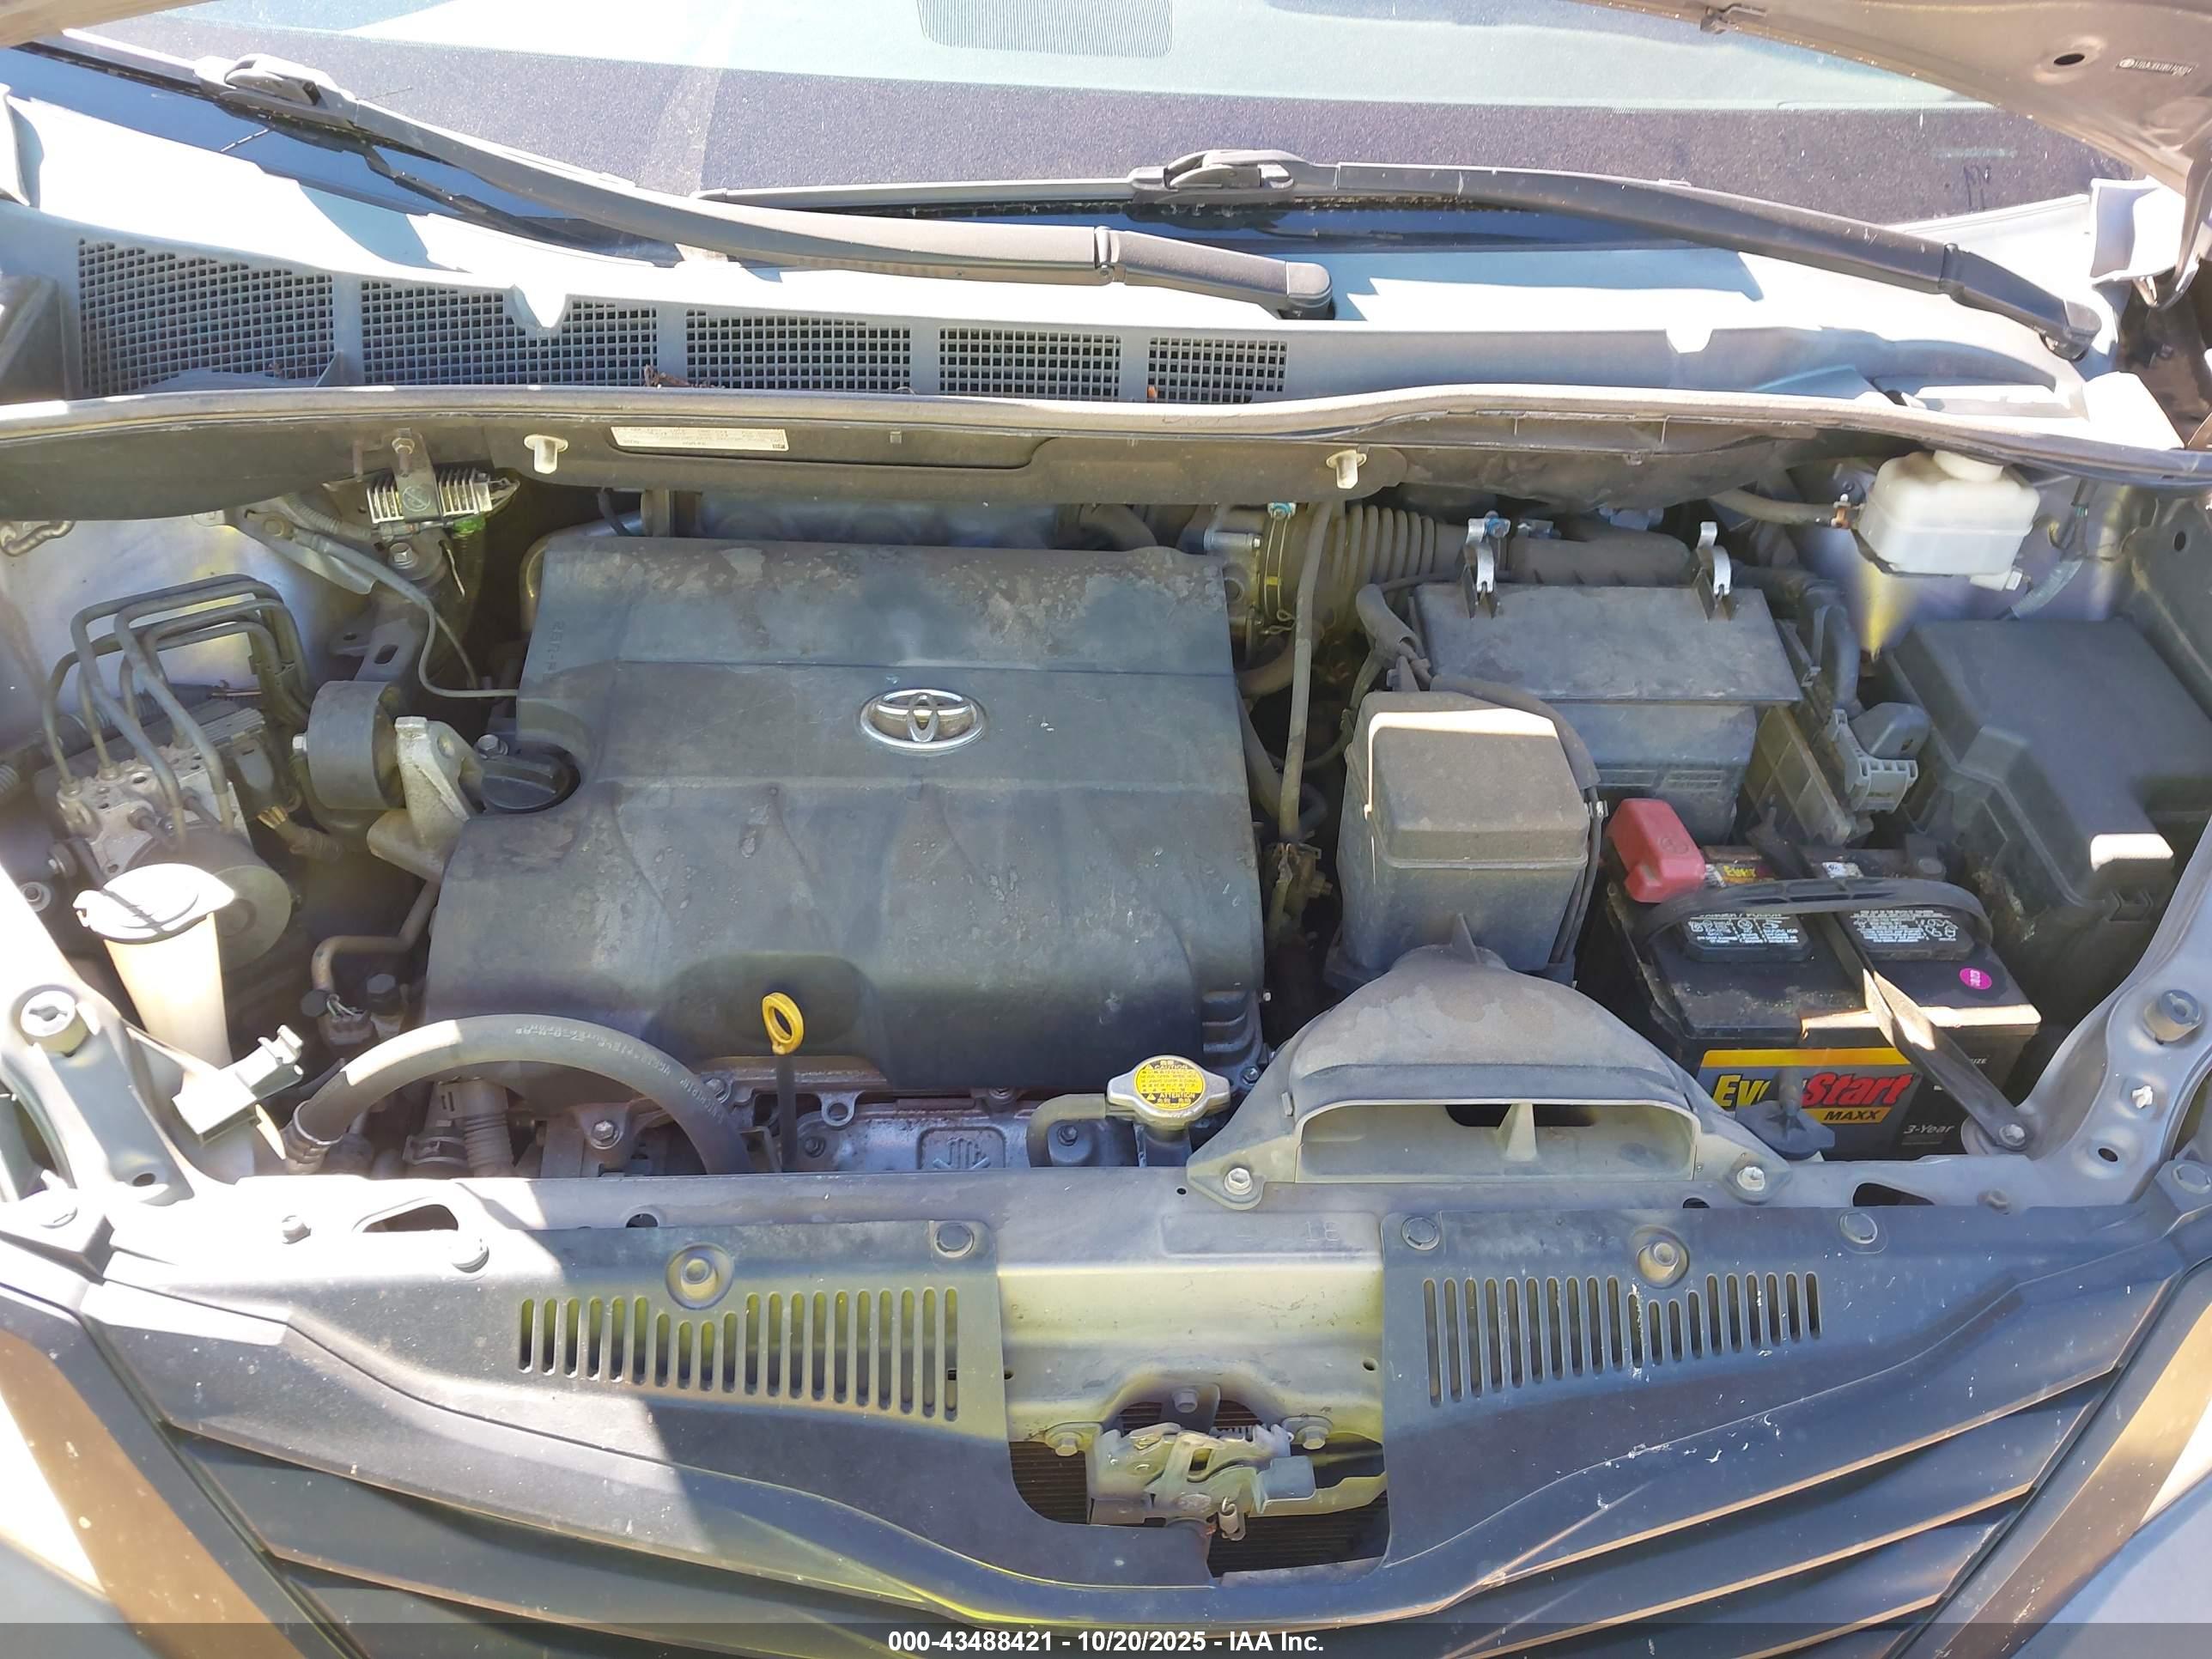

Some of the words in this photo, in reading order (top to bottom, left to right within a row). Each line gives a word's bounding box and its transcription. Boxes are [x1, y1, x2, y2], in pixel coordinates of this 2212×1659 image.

[1712, 1073, 1914, 1107] EvStart
[1823, 1109, 1881, 1121] MAXX
[1903, 1124, 1955, 1134] 3-Year
